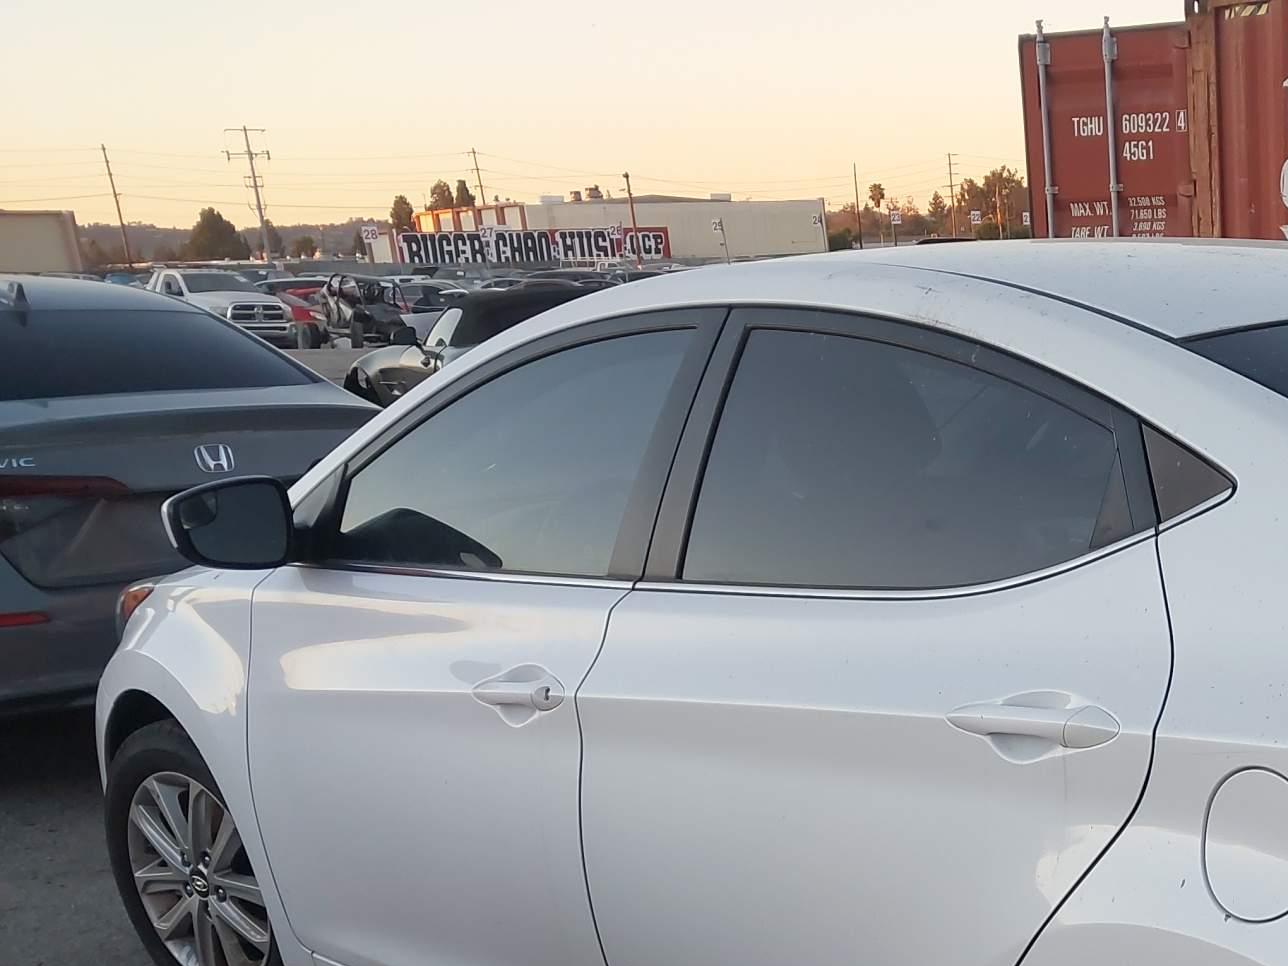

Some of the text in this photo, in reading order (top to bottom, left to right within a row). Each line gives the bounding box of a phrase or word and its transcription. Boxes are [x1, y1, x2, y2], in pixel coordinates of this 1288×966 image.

[1071, 116, 1104, 137] TGHU
[1122, 112, 1170, 134] 609322
[1123, 140, 1154, 161] 45G1
[1151, 196, 1166, 206] KGS
[971, 213, 982, 222] 22
[1153, 208, 1167, 219] LBS
[363, 229, 378, 240] 28
[480, 227, 493, 239] 27
